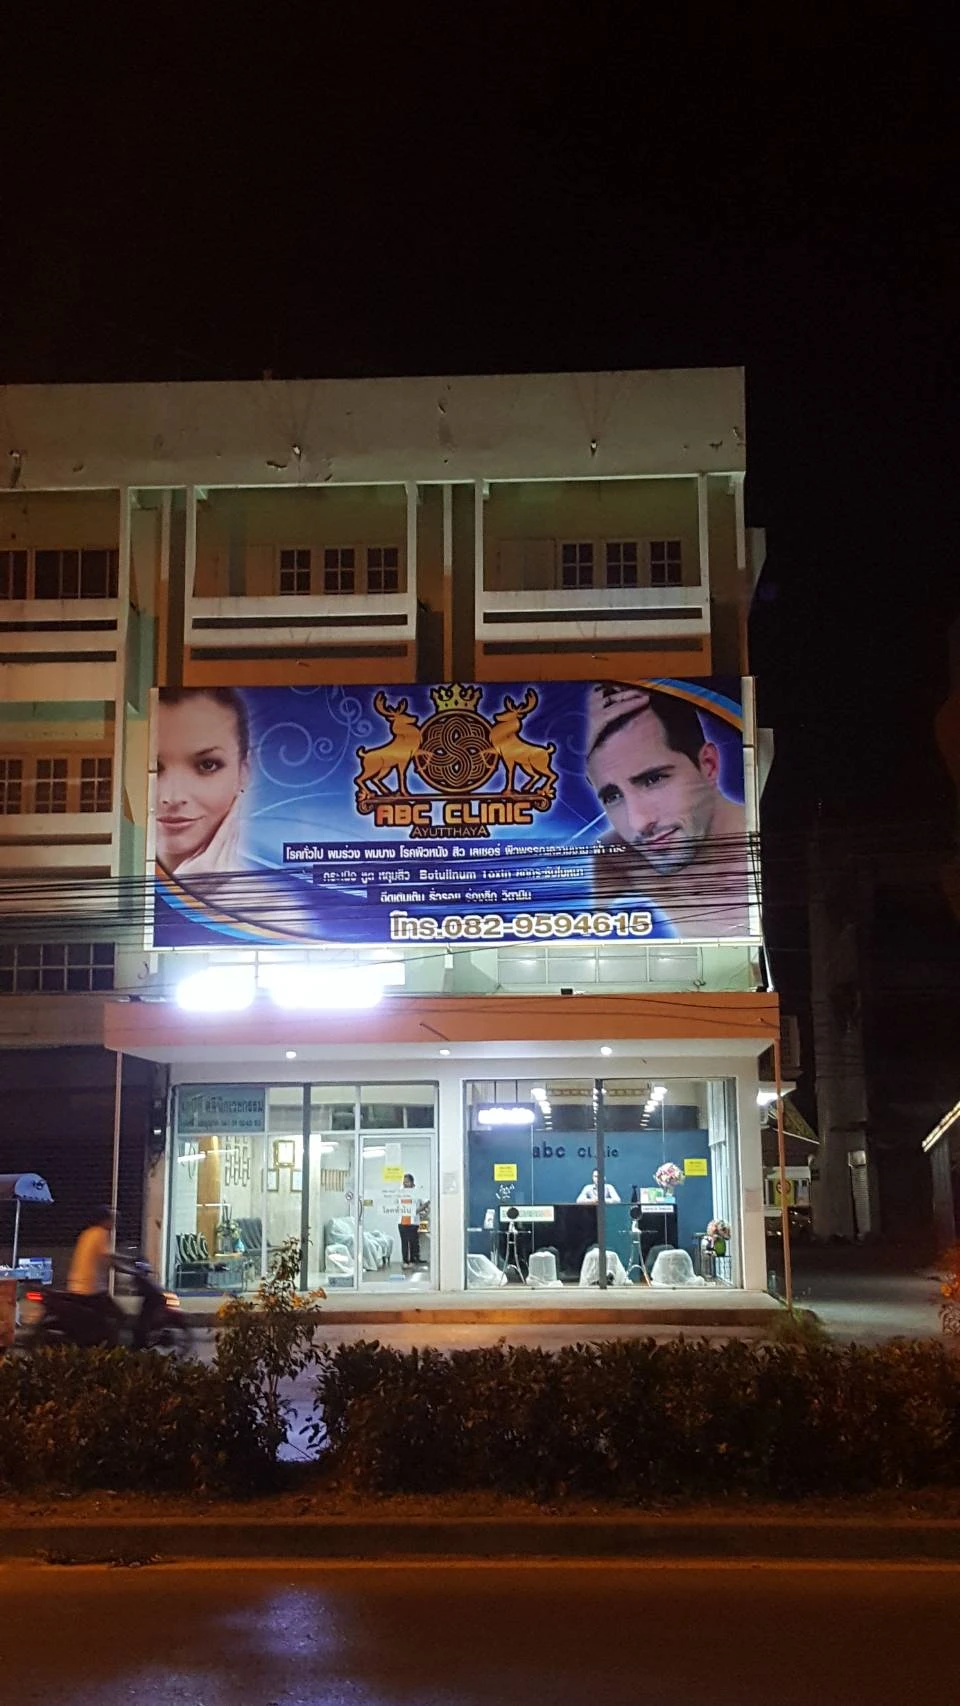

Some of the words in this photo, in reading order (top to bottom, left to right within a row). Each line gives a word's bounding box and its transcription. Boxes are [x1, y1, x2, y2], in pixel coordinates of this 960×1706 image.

[376, 802, 430, 825] ABC
[445, 801, 532, 824] CLINIC
[412, 825, 489, 838] AYUTTHAYA
[286, 845, 324, 860] โรคทั่วไป
[328, 845, 361, 859] ผมร่วง
[364, 848, 396, 859] ผมบาง
[399, 845, 448, 858] โรคผิวหนัง
[452, 845, 465, 857] สิว
[378, 868, 410, 884] หลุมสิว
[419, 869, 477, 881] Botulinum
[390, 911, 652, 939] โทร.082-9594615
[532, 1141, 566, 1158] abc
[577, 1145, 619, 1158] clic
